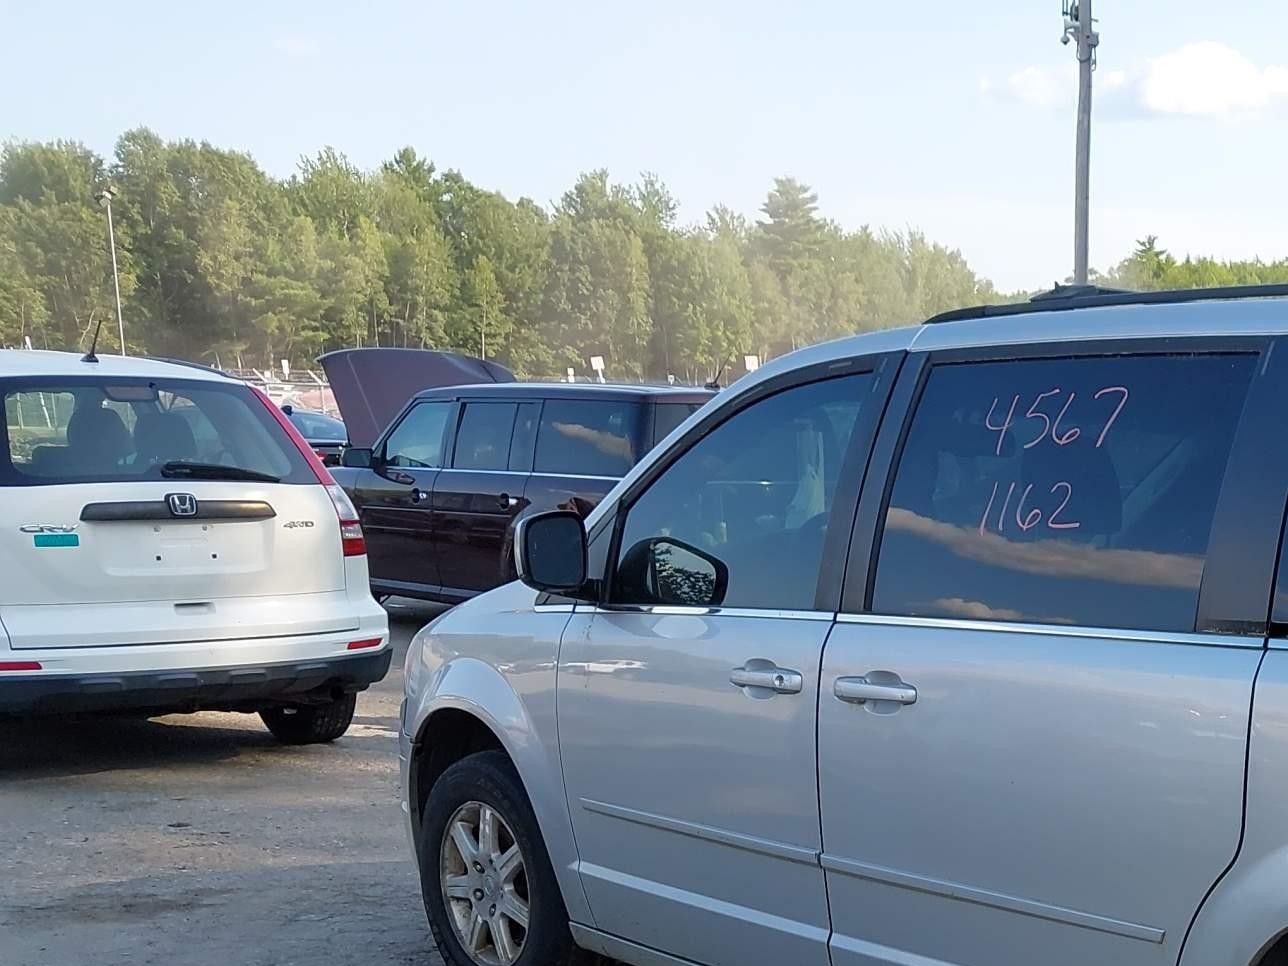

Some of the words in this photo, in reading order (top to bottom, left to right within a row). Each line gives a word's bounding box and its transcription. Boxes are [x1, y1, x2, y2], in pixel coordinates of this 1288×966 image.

[984, 385, 1130, 456] 4567
[283, 520, 315, 529] 4WD
[979, 481, 1081, 537] 1162
